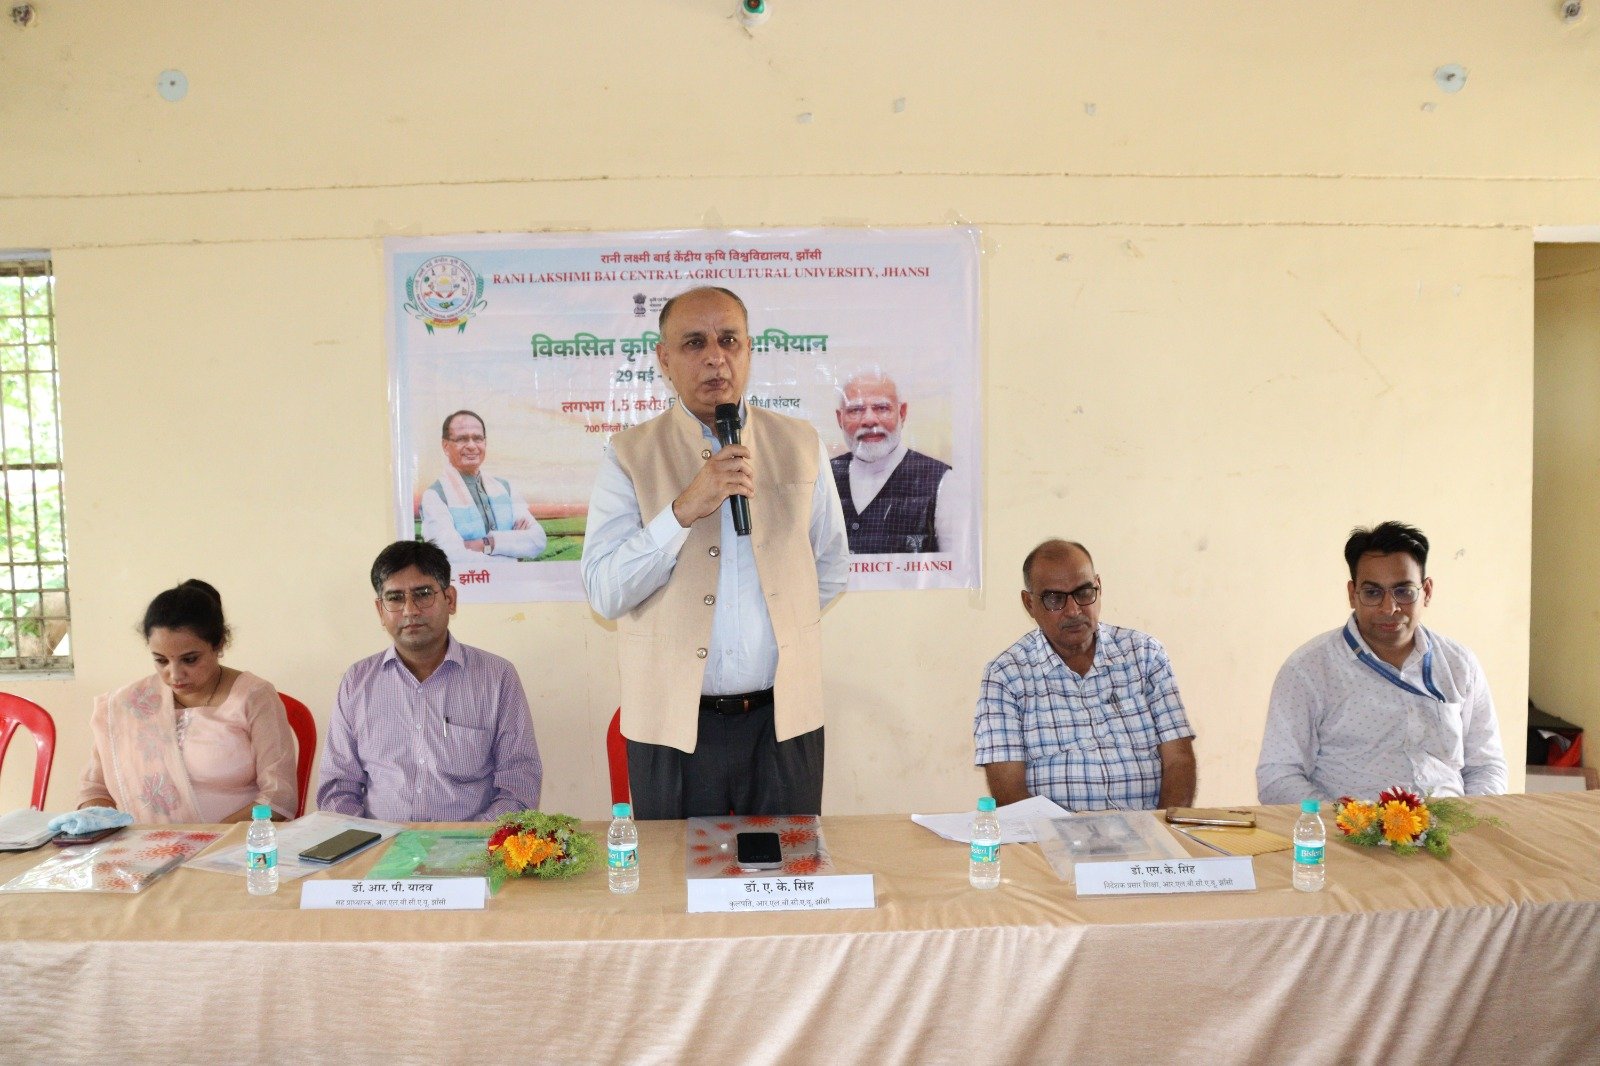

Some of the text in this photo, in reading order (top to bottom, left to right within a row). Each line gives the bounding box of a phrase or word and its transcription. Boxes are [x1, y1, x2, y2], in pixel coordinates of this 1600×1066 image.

[601, 251, 621, 264] रानी
[624, 250, 650, 264] लक्ष्मी
[653, 251, 671, 264] बाई
[705, 249, 726, 264] कृषि
[729, 249, 793, 262] विश्वविद्यालय,
[796, 248, 822, 261] झाँसी
[493, 266, 930, 284] RANI LAKSHMI BAI CENTRAL AGRICULTURAL UNIVERSITY, JHANSI
[531, 332, 616, 358] विकसित
[616, 370, 633, 382] 29
[636, 367, 655, 383] मई
[562, 400, 605, 413] लगभग
[611, 399, 630, 412] 1.5
[773, 396, 801, 409] संवाद
[585, 424, 600, 433] 700
[903, 560, 953, 572] JHANSI
[459, 569, 490, 586] झाँसी
[1131, 863, 1195, 876] डॉ. एस. के. सिंह
[352, 881, 433, 893] डॉ. आर. पी. यादव
[744, 878, 814, 894] डॉ. ए. के. सिंह
